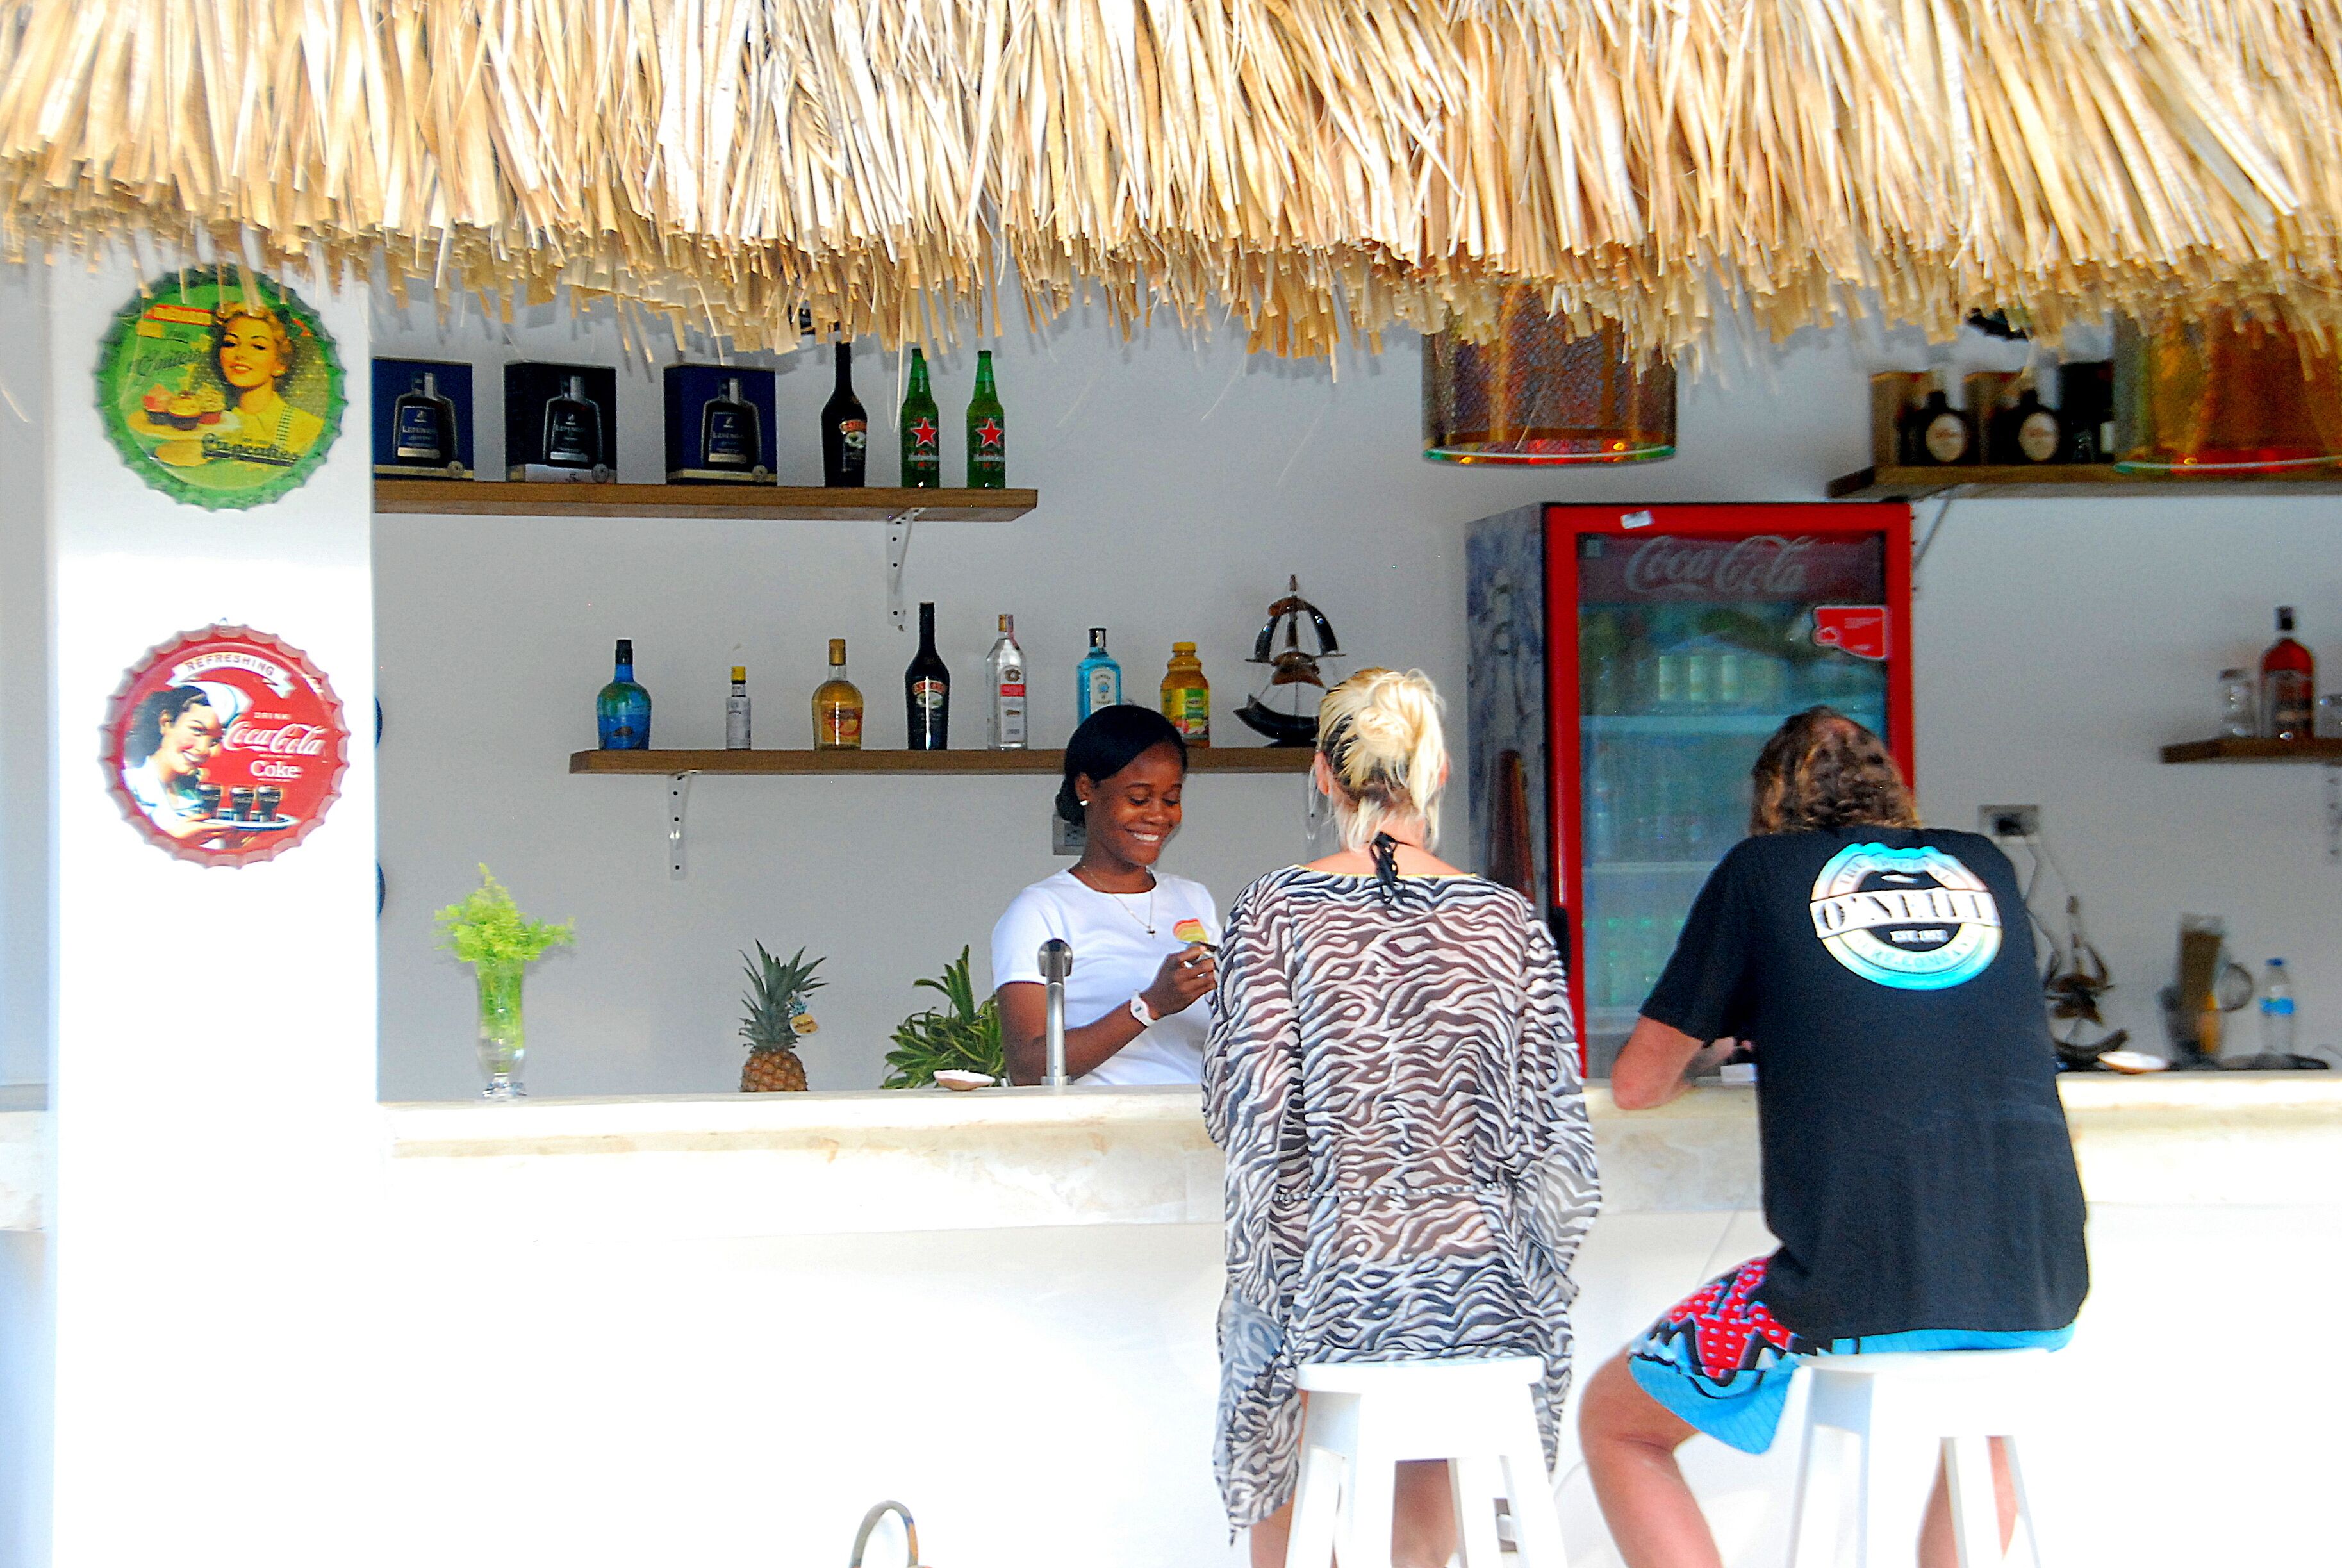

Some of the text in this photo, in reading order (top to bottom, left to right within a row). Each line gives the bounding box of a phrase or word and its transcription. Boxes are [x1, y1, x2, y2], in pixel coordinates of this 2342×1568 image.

[186, 653, 275, 677] REFRESHING
[254, 711, 291, 720] DRINK
[222, 720, 329, 755] Coca-Cola
[250, 759, 304, 779] Coke
